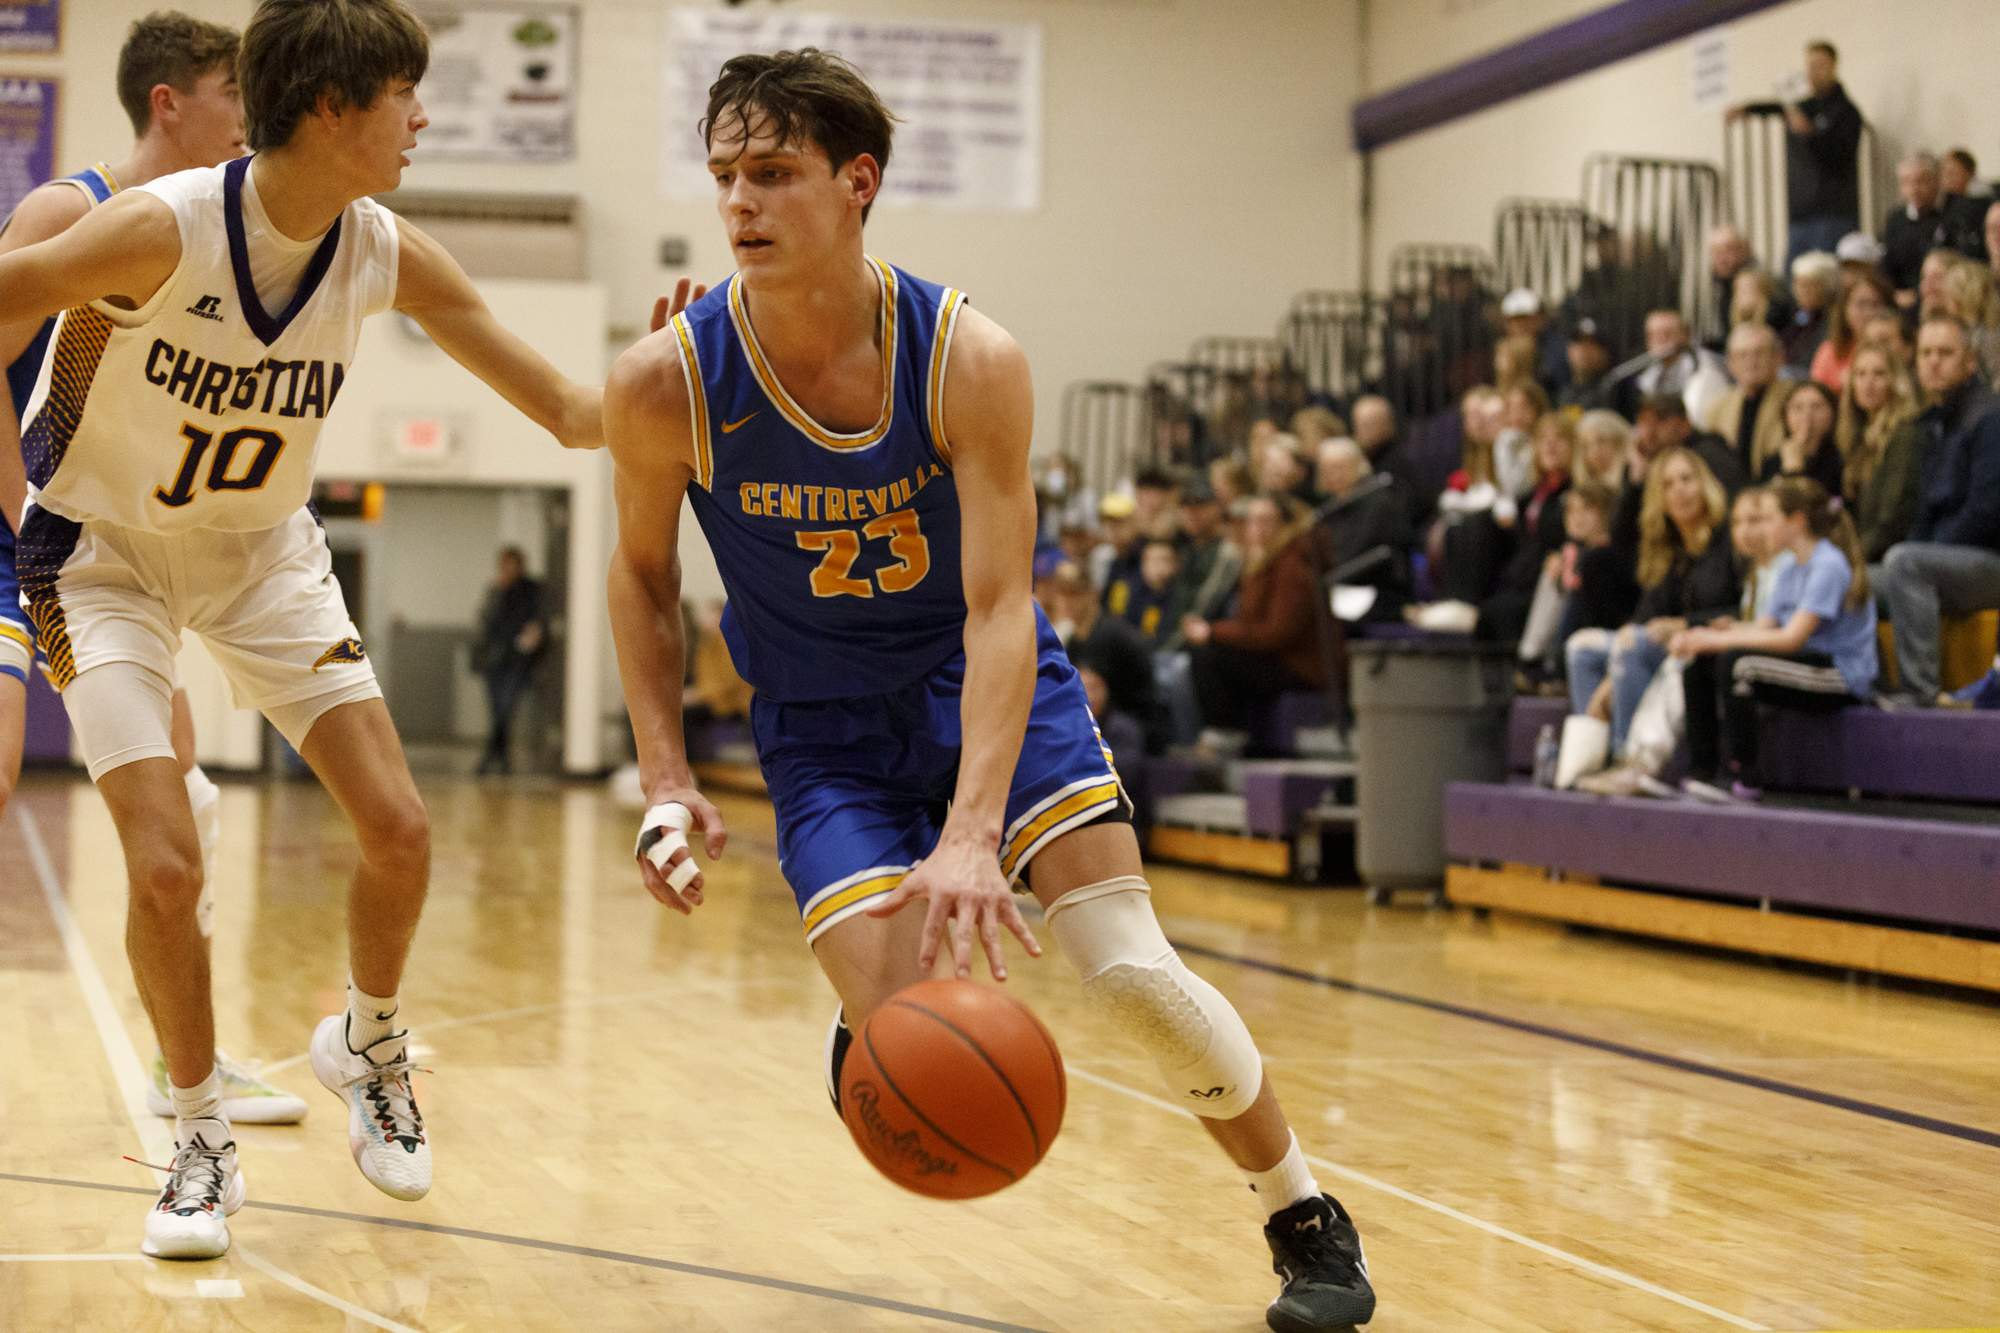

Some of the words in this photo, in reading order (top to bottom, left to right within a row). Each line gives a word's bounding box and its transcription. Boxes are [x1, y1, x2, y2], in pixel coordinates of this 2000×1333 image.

[185, 306, 224, 322] RUSSELL
[152, 420, 287, 509] 10
[795, 508, 931, 598] 23
[850, 1080, 958, 1177] Rawlings
